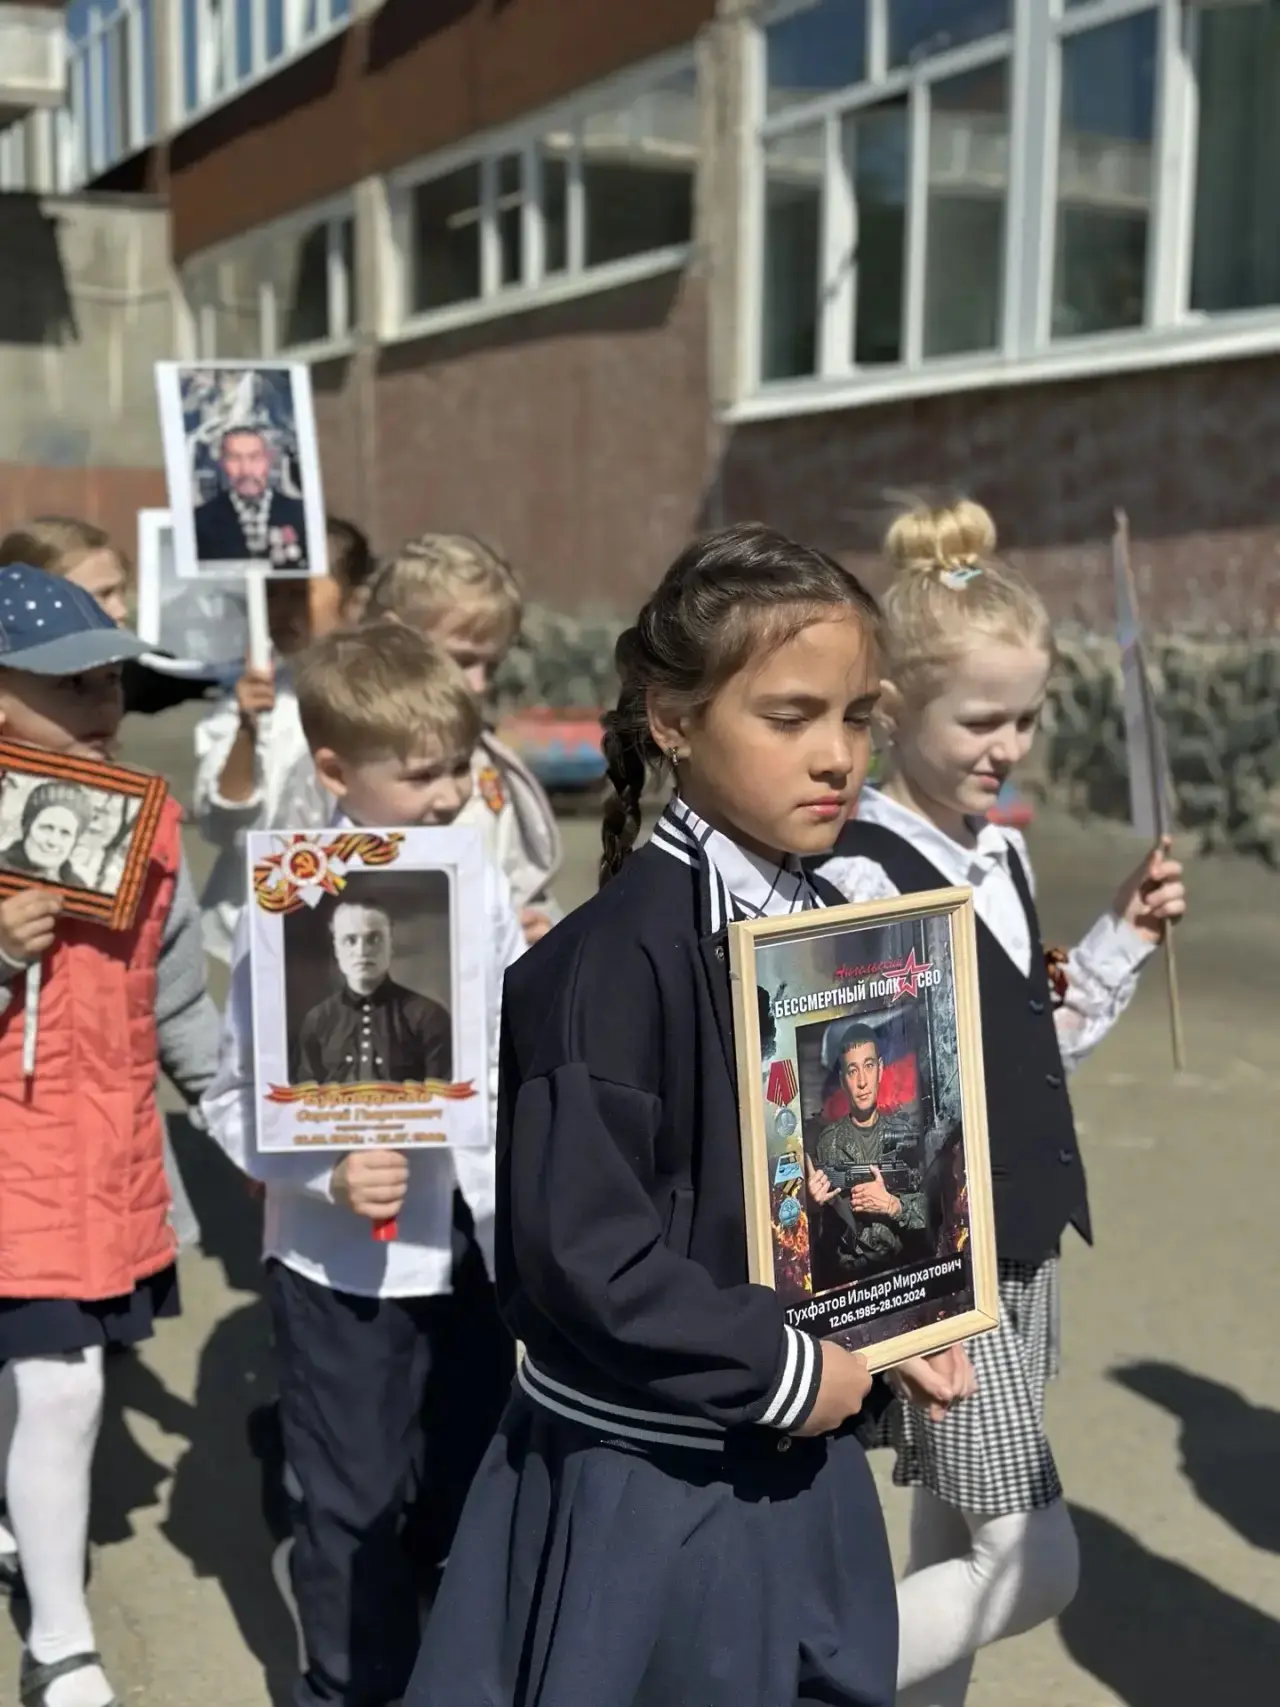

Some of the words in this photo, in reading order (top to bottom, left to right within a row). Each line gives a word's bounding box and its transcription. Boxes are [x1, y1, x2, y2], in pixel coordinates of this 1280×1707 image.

[775, 980, 866, 1018] БЕССМЕРТНЫЙ
[870, 977, 900, 997] ПОЛК
[917, 969, 941, 988] СВО
[786, 1299, 847, 1325] Тухфатов
[847, 1280, 892, 1305] Ильдар
[892, 1258, 962, 1291] Мирхатович
[828, 1287, 926, 1329] 12.06.1985-28.10.2024
